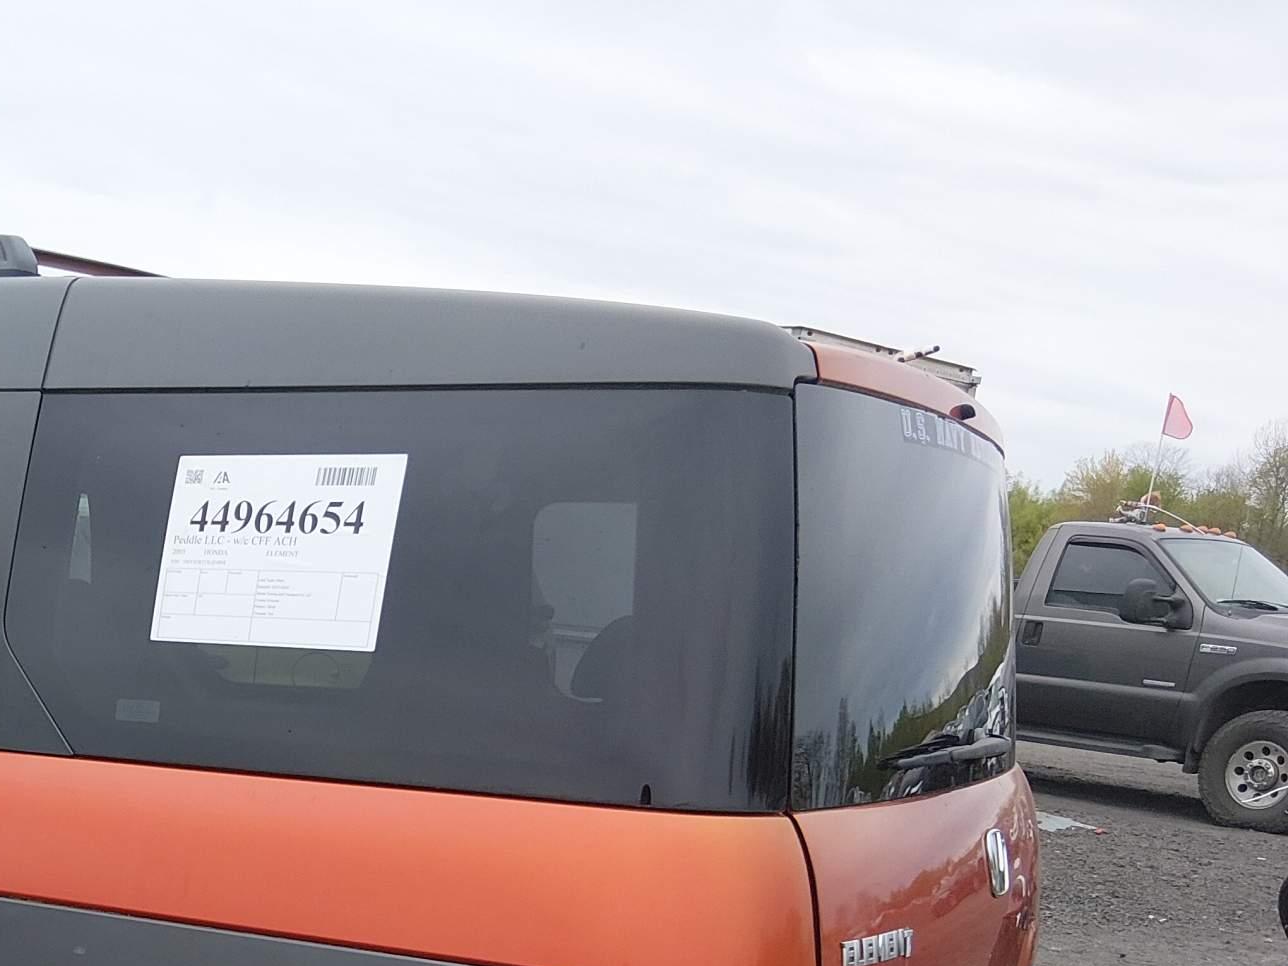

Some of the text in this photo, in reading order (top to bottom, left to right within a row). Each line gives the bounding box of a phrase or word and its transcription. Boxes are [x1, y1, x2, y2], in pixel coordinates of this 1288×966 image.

[189, 500, 365, 534] 44964654
[173, 535, 203, 545] Peddle
[204, 535, 225, 545] LLC
[274, 537, 298, 547] ACH
